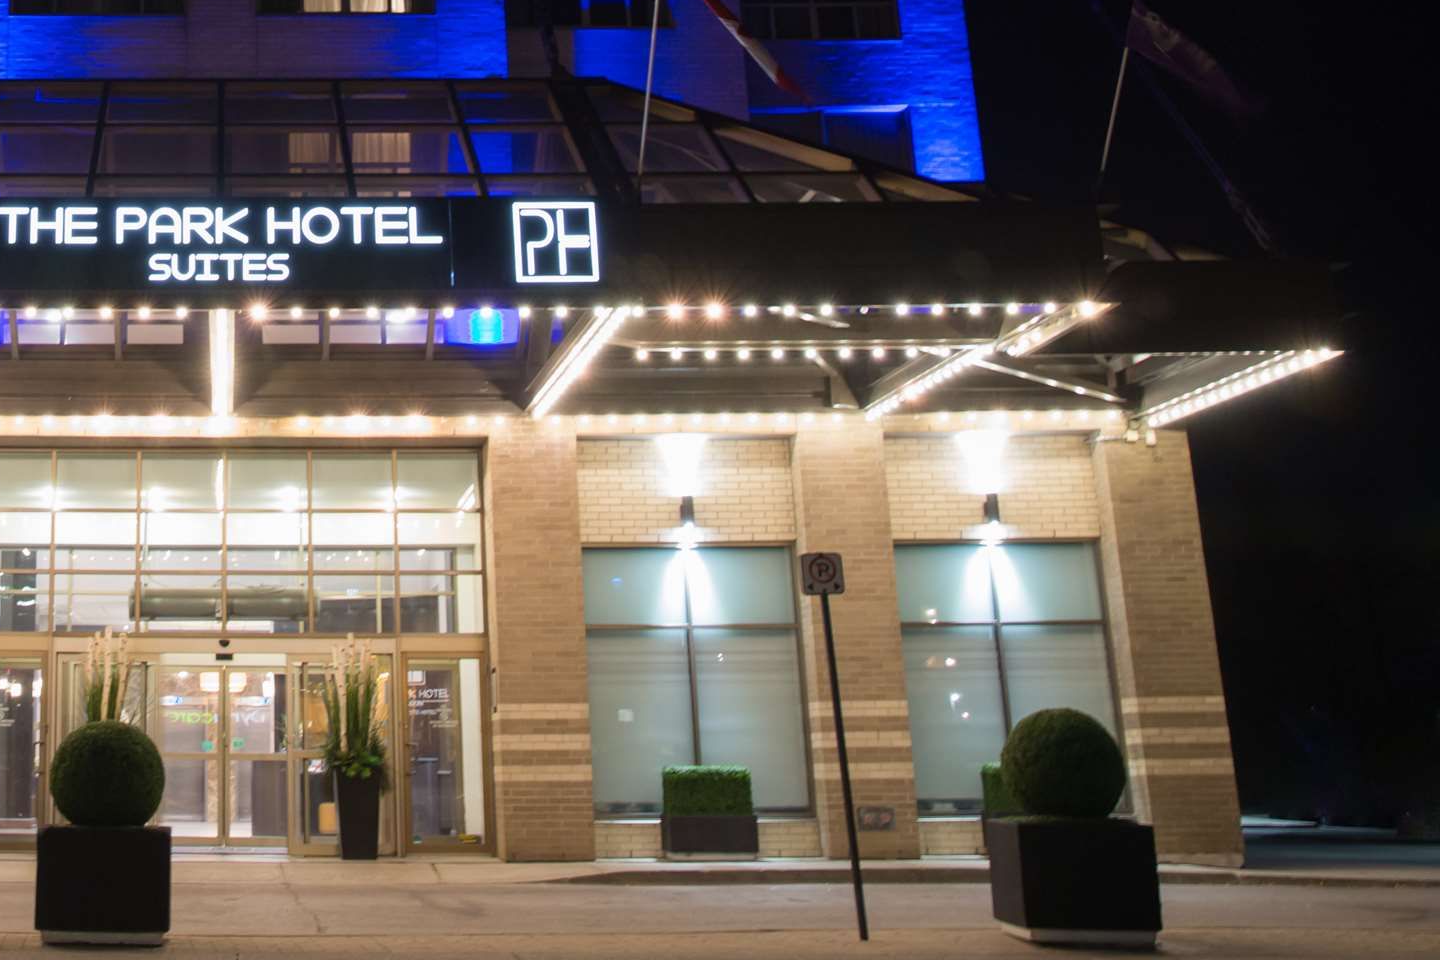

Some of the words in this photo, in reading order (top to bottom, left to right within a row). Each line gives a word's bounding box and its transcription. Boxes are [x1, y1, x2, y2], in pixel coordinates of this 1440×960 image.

[115, 206, 249, 244] PARK
[267, 206, 443, 244] HOTEL
[148, 253, 290, 281] SUITES
[418, 688, 449, 699] HOTEL
